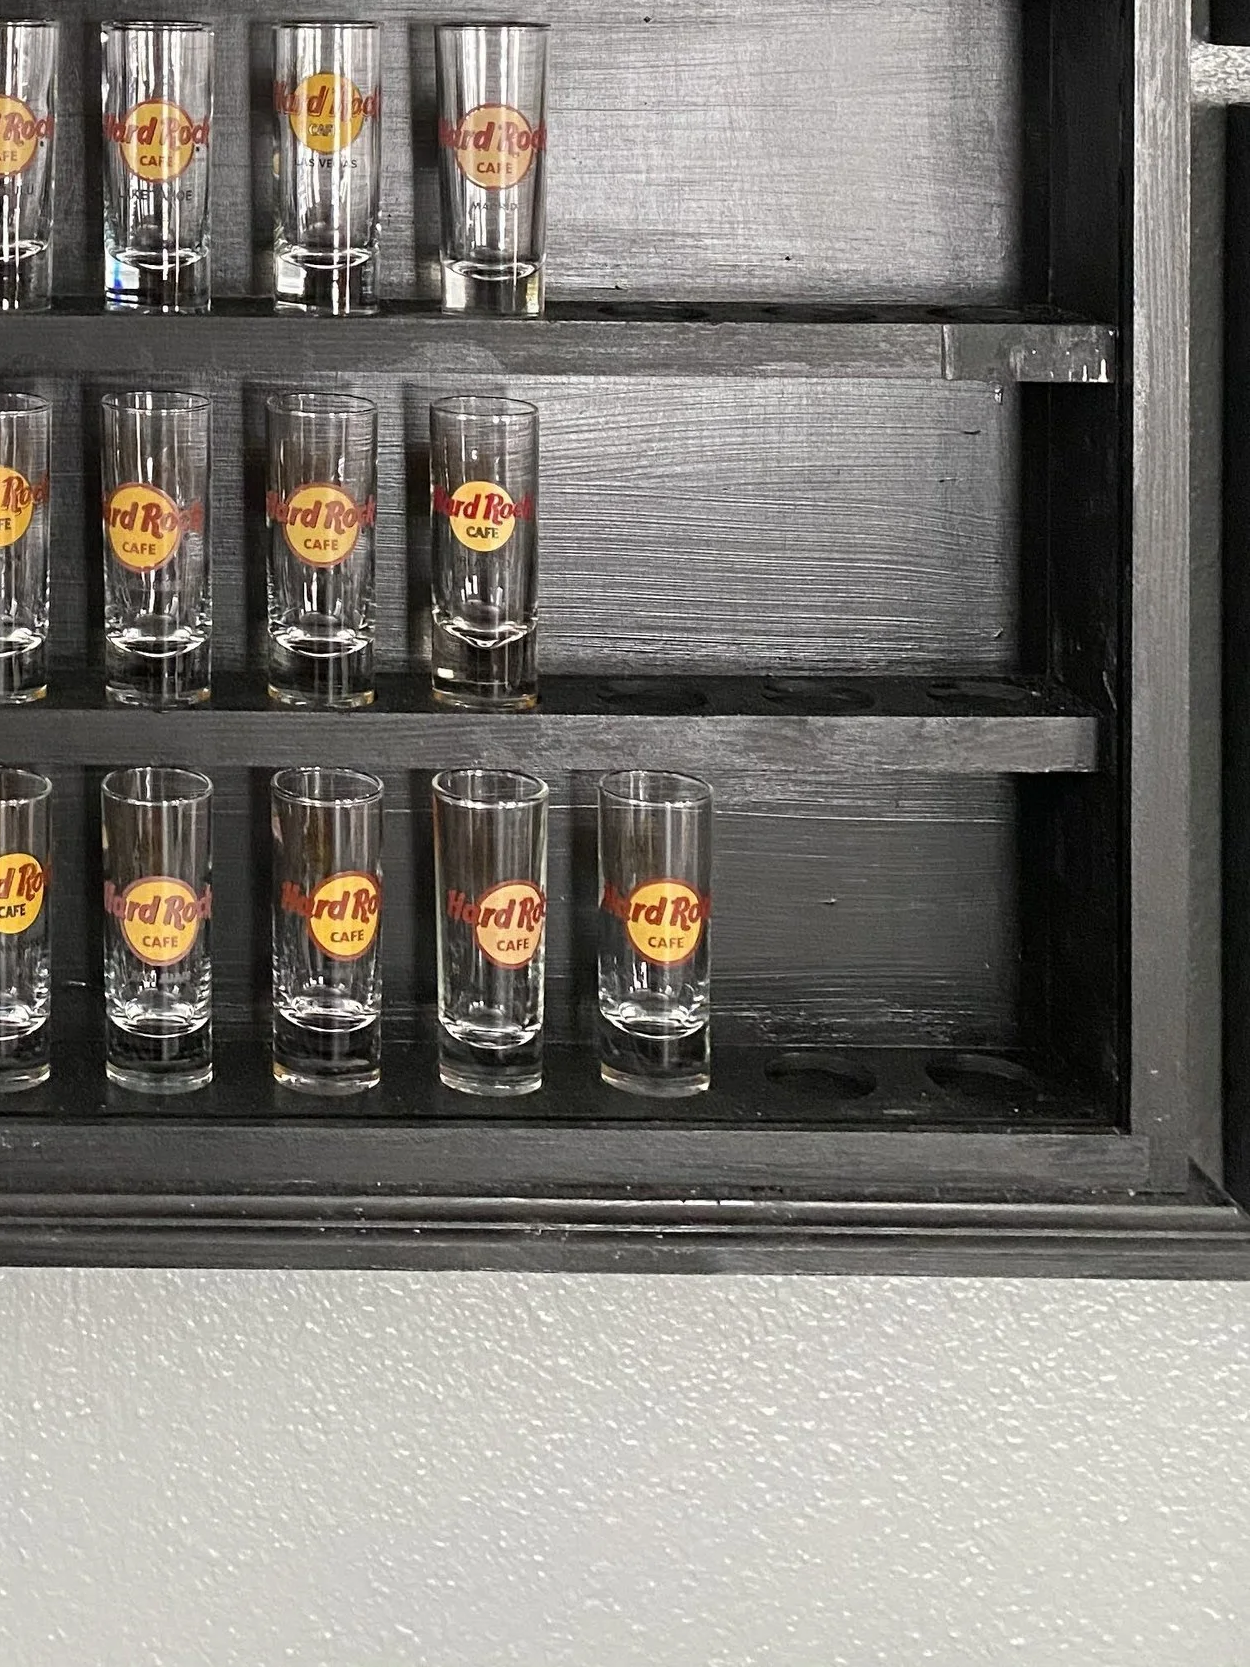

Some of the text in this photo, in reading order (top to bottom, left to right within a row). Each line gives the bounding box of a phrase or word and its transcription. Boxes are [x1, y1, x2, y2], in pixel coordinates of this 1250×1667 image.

[308, 123, 340, 136] CAF
[139, 155, 173, 167] CAFE
[319, 158, 358, 169] VEAS
[477, 162, 513, 174] CAFE
[119, 190, 148, 201] LKE
[465, 525, 499, 539] CAFE
[122, 541, 156, 555] CAFE
[303, 538, 338, 551] CAFE
[19, 862, 52, 902] Ro
[352, 888, 381, 925] Ro
[517, 885, 546, 932] Ro
[670, 894, 711, 931] Ro
[142, 936, 178, 948] CAFE
[330, 929, 364, 943] CAFE
[648, 937, 684, 948] CAFE
[496, 938, 529, 952] CAFE
